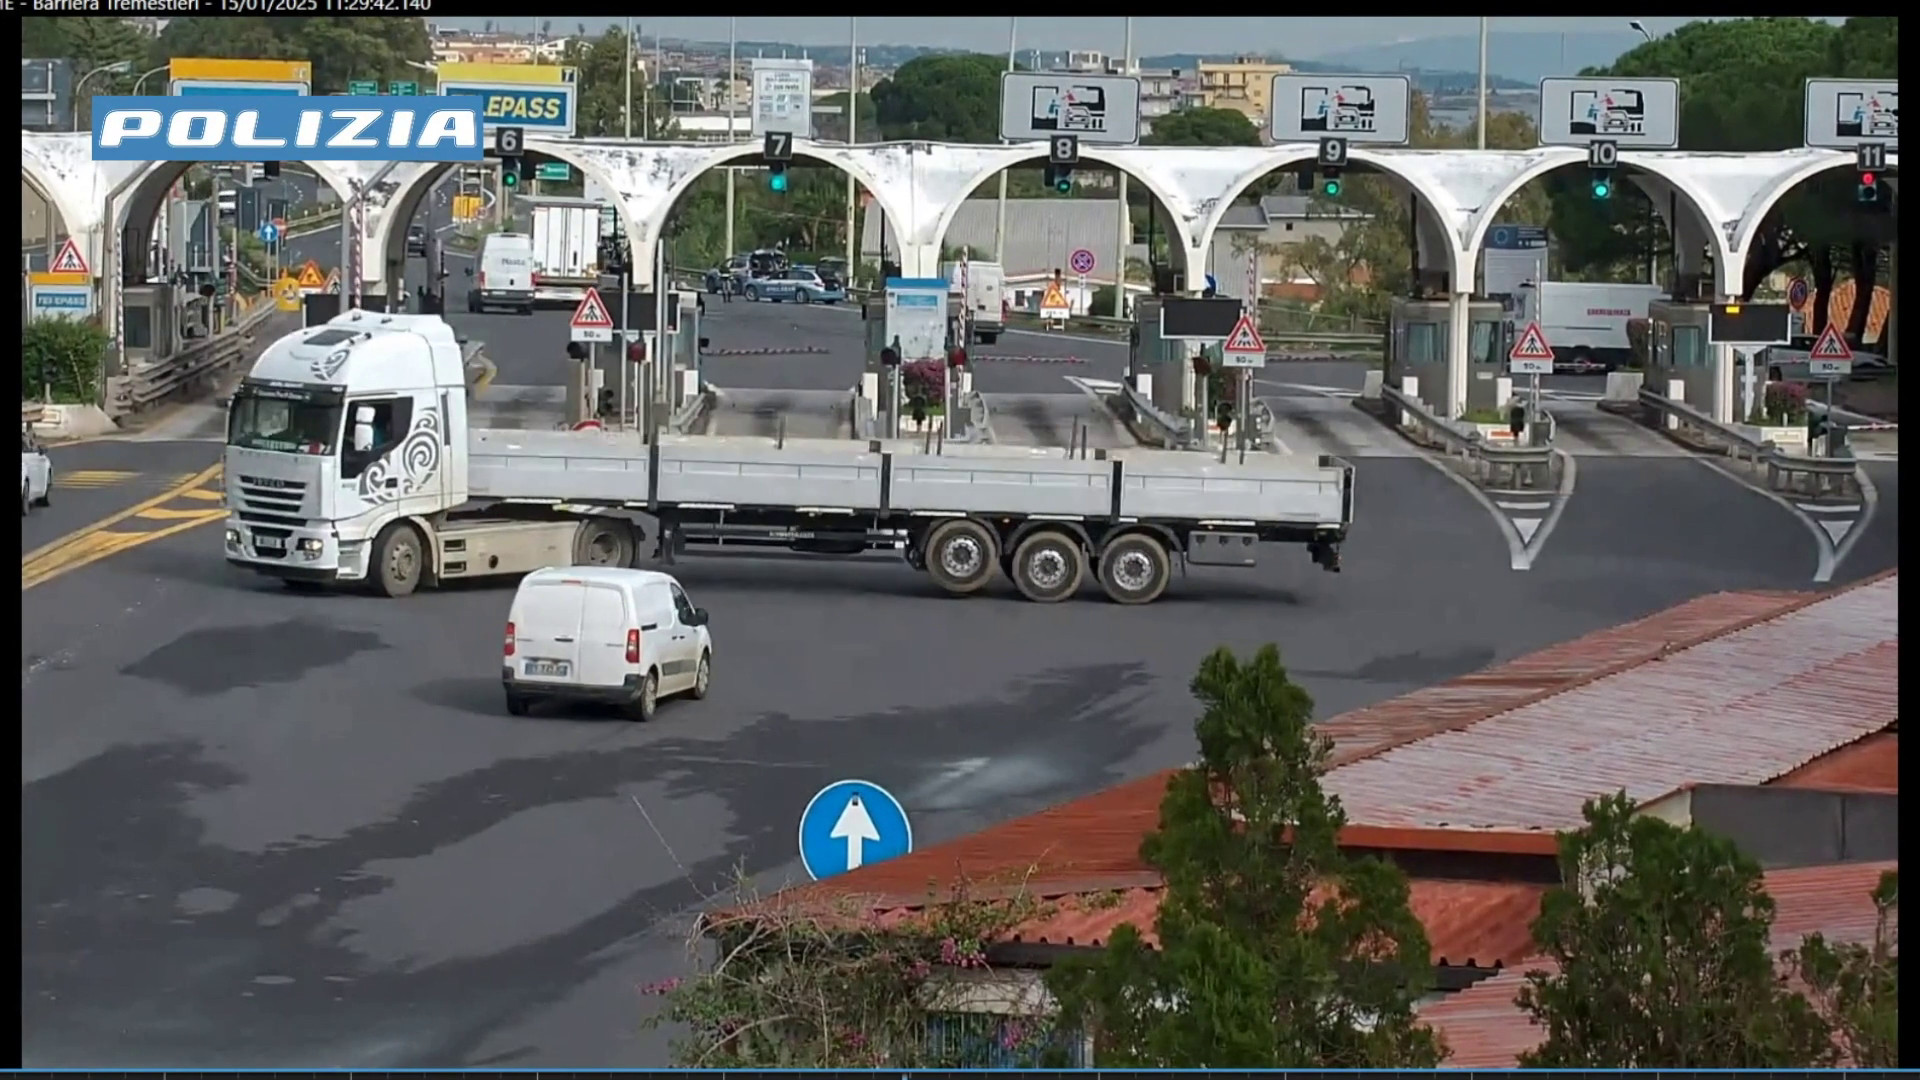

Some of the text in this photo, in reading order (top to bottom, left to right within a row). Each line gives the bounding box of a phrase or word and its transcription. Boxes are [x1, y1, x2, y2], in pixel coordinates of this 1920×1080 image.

[474, 95, 561, 120] EPASS
[501, 129, 517, 151] 6
[771, 134, 786, 156] 7
[1056, 137, 1072, 159] 8
[1326, 139, 1341, 161] 9
[1591, 143, 1616, 164] 10
[1862, 145, 1880, 167] 11
